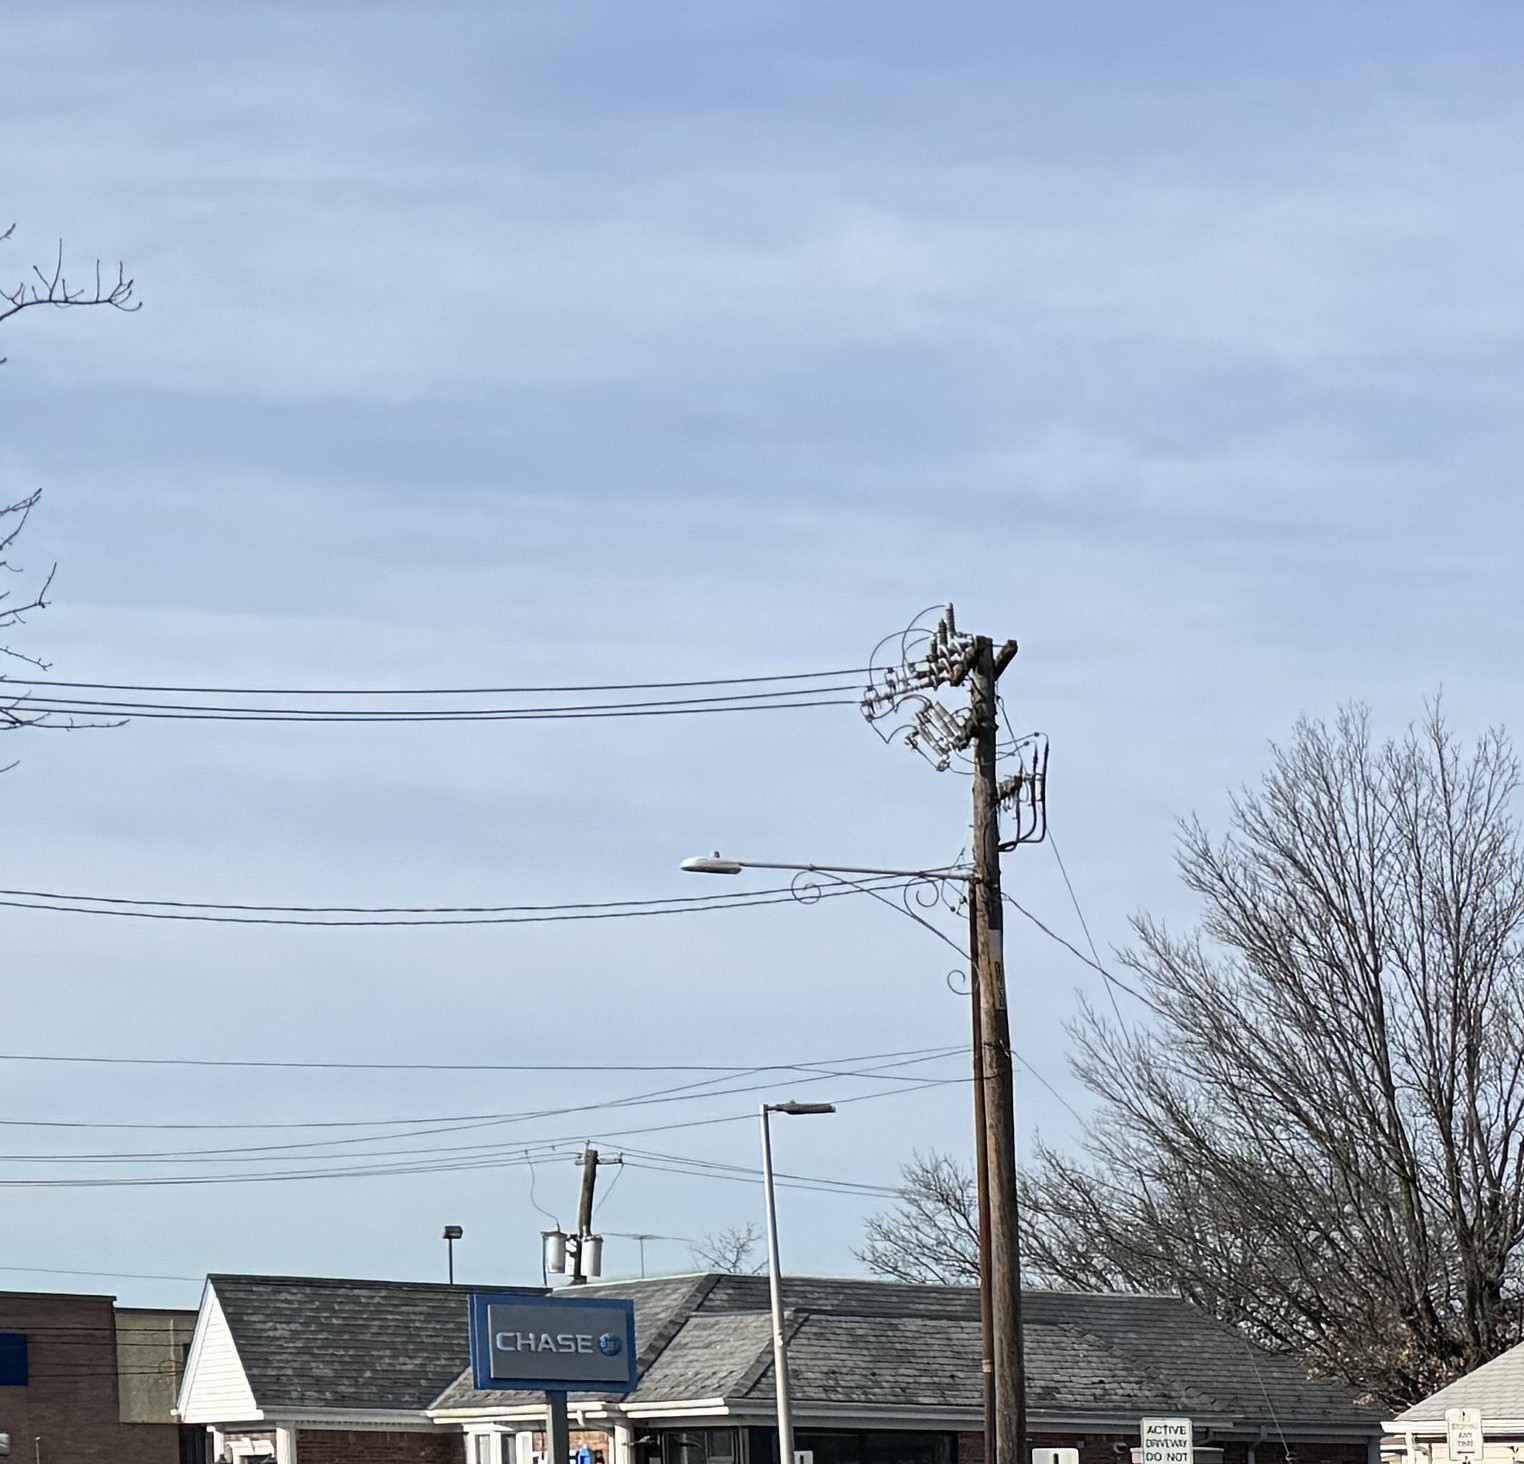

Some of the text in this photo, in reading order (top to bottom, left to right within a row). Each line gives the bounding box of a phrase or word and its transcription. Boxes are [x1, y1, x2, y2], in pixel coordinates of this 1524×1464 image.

[496, 1332, 593, 1353] CHASE
[1147, 1425, 1187, 1435] ACTIVE
[1146, 1452, 1187, 1461] DO NOT
